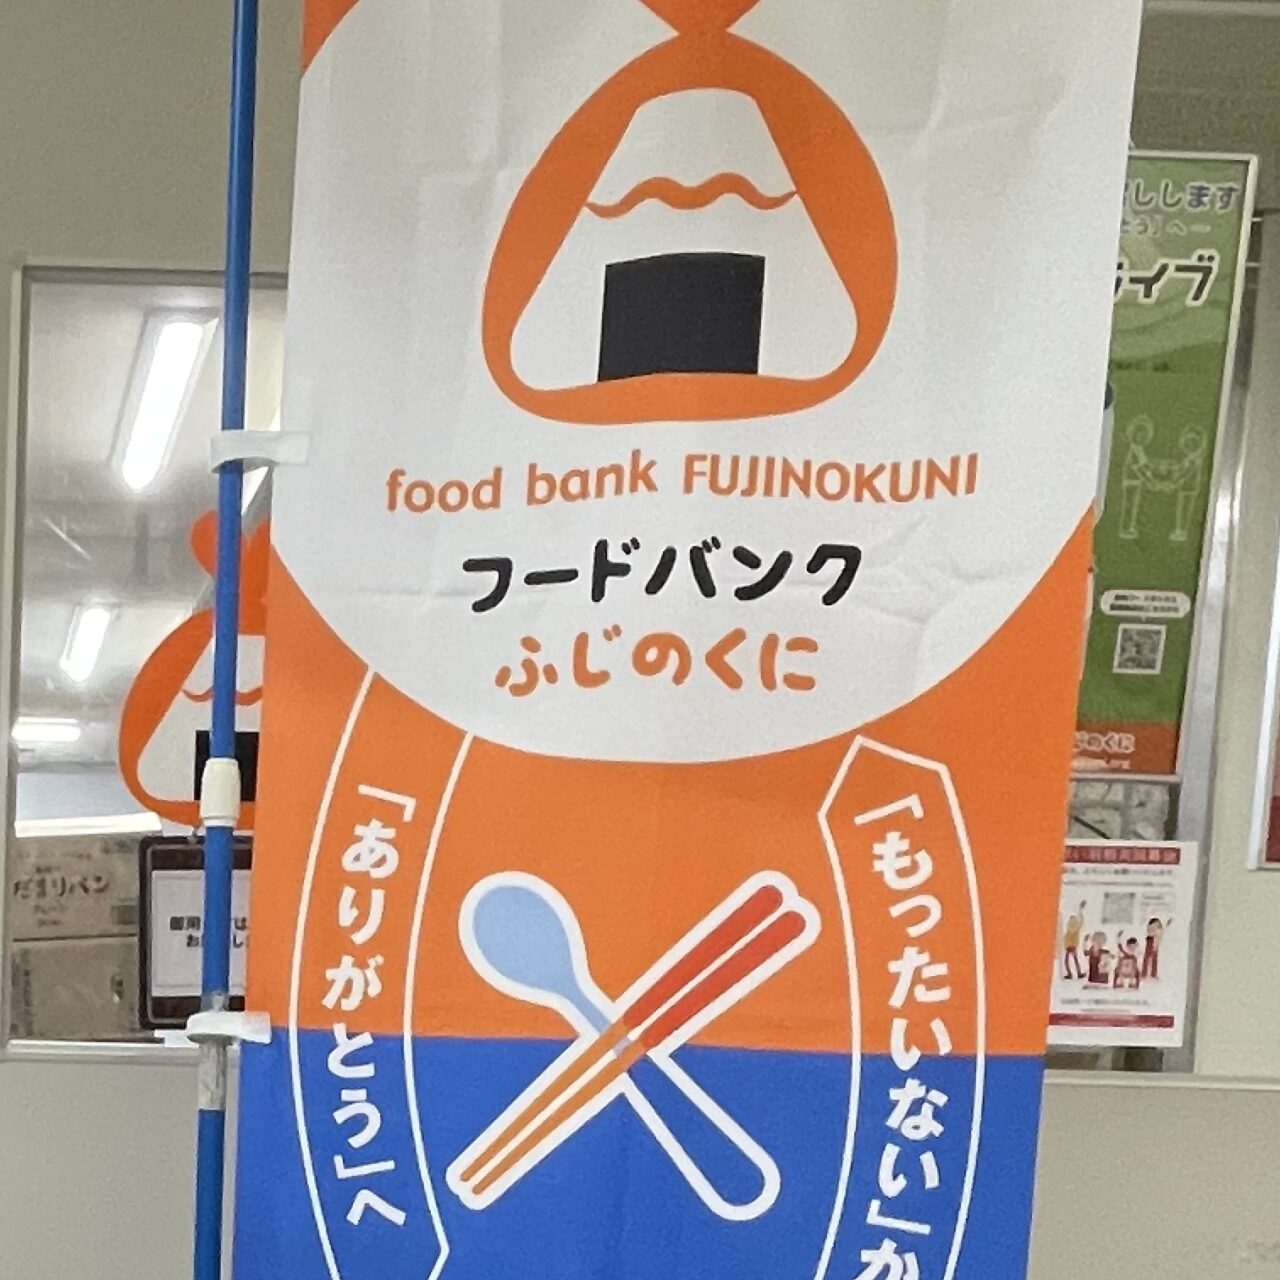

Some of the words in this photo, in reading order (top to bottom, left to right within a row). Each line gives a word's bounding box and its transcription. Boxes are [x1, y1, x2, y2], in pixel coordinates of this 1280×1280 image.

[1124, 180, 1240, 210] しします
[386, 467, 503, 512] food
[526, 449, 658, 506] bank
[683, 452, 979, 502] FUJINOKUNI
[462, 536, 862, 613] フードバンク
[494, 624, 820, 698] ふじのくに
[320, 783, 417, 1228] 「ありがとう」へ
